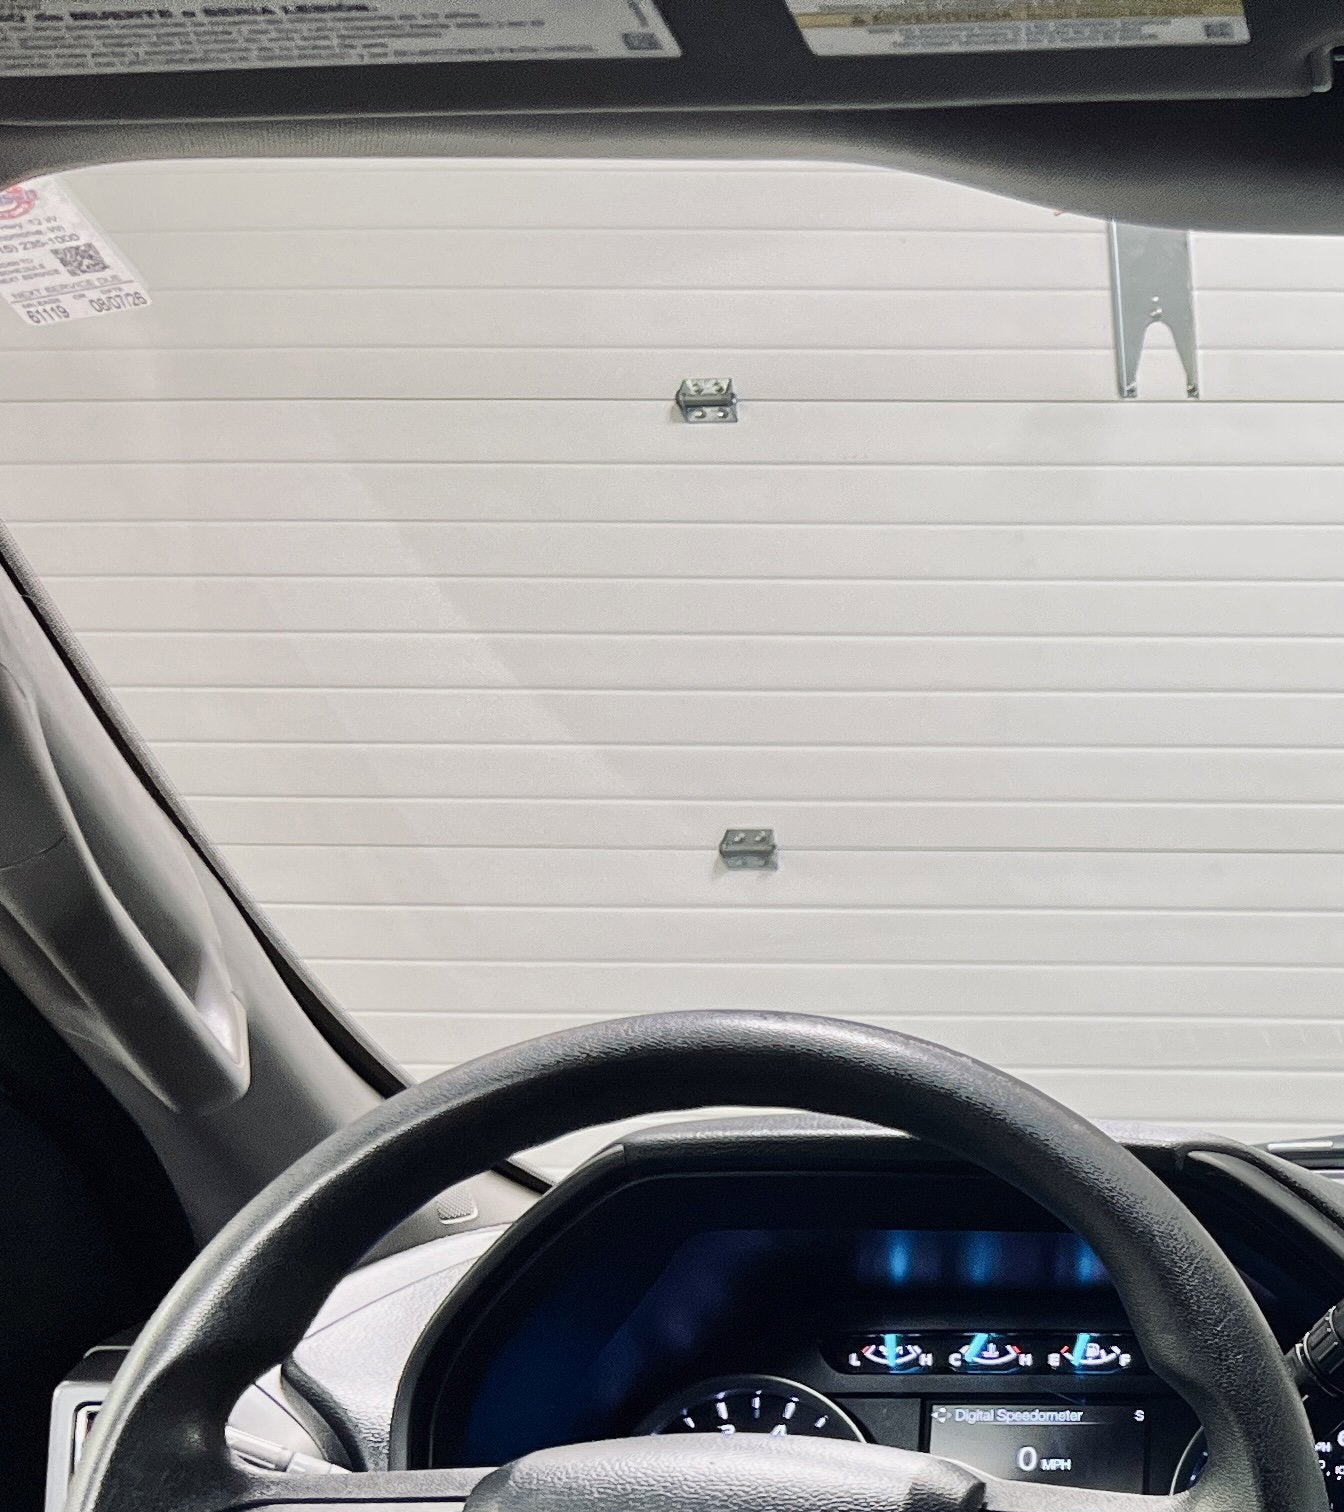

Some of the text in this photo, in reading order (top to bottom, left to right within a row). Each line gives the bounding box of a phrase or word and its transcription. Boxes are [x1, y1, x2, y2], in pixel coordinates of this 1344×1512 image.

[919, 1353, 933, 1366] H
[949, 1353, 962, 1366] C
[1019, 1353, 1033, 1366] H
[1048, 1353, 1060, 1366] E
[1118, 1353, 1132, 1366] F
[955, 1409, 1084, 1424] Digital Speedometer
[1134, 1410, 1145, 1421] S
[1016, 1446, 1072, 1471] 0 MPH
